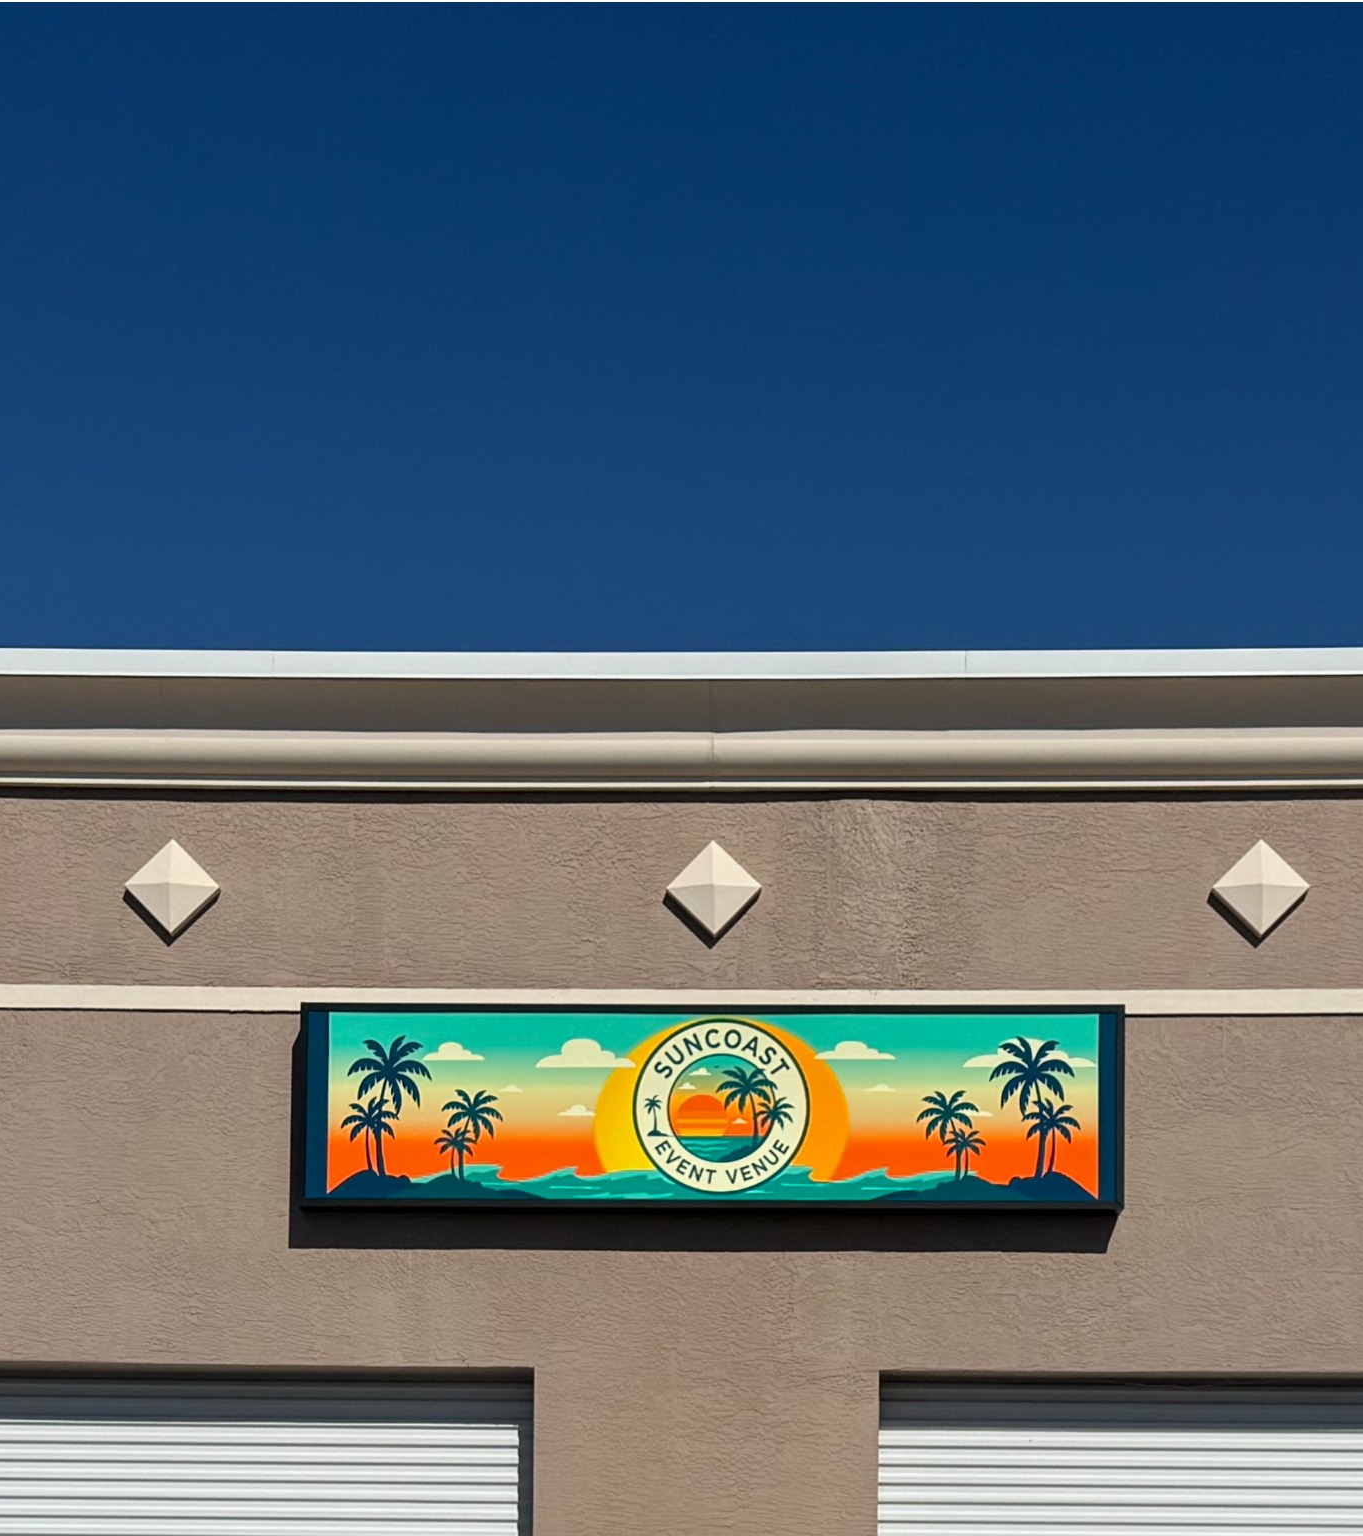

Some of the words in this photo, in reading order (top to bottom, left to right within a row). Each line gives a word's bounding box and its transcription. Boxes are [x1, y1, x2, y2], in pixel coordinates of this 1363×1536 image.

[654, 1029, 790, 1079] SUNCOAST
[654, 1140, 717, 1184] EVENT
[725, 1139, 790, 1184] VENUE
